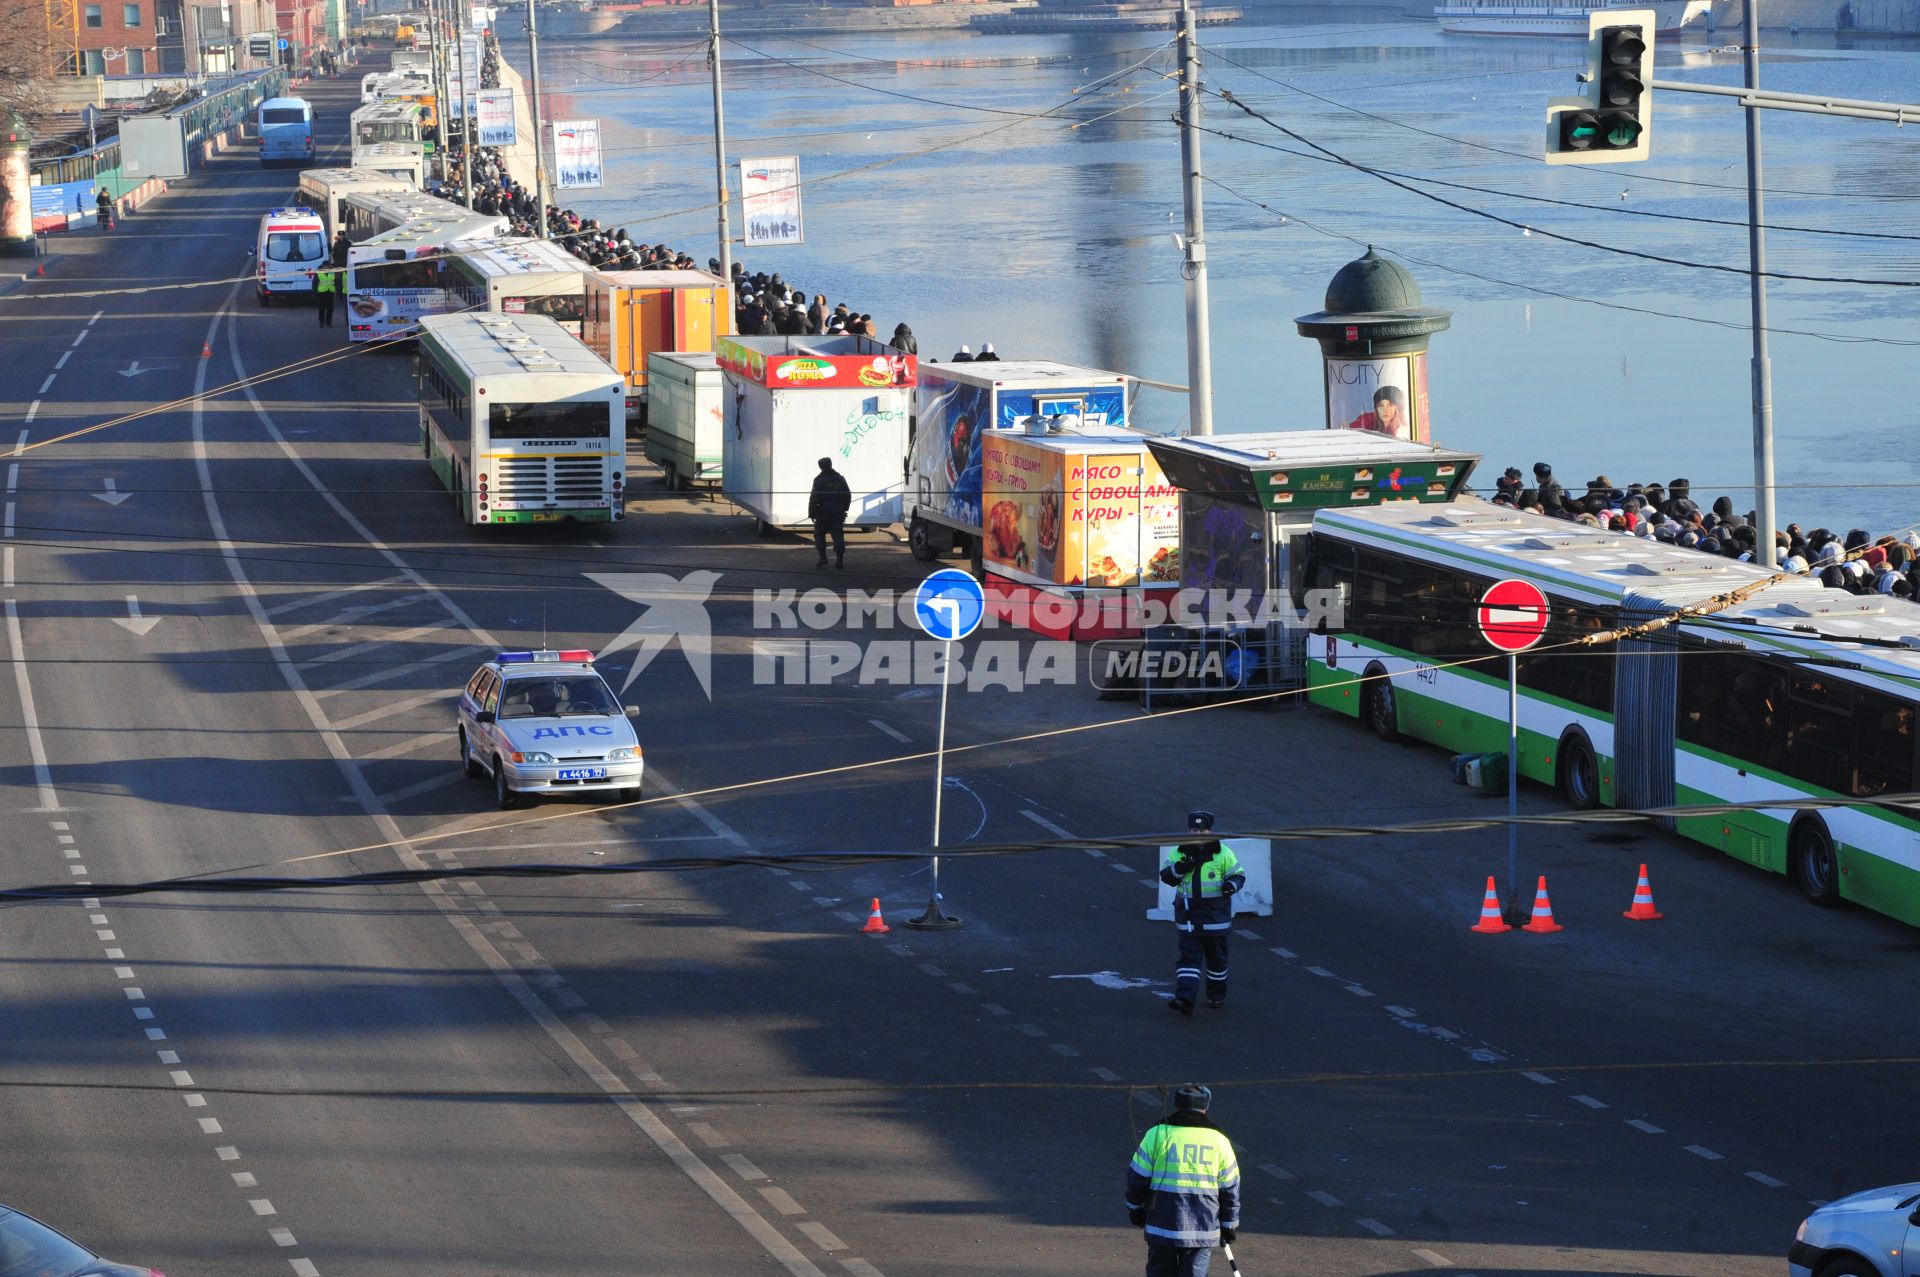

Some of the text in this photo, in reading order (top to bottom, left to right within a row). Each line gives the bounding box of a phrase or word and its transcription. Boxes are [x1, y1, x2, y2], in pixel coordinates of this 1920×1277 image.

[794, 361, 819, 370] PIZZA
[788, 371, 825, 380] ROMA
[986, 448, 1004, 464] МЯСО
[986, 468, 1004, 484] КУРЫ
[1071, 465, 1121, 480] МЯСО
[1071, 487, 1083, 500] С
[1071, 507, 1123, 521] КУРЫ
[533, 726, 613, 739] ДПС
[570, 769, 591, 779] 4416
[1166, 1142, 1214, 1166] ДПС
